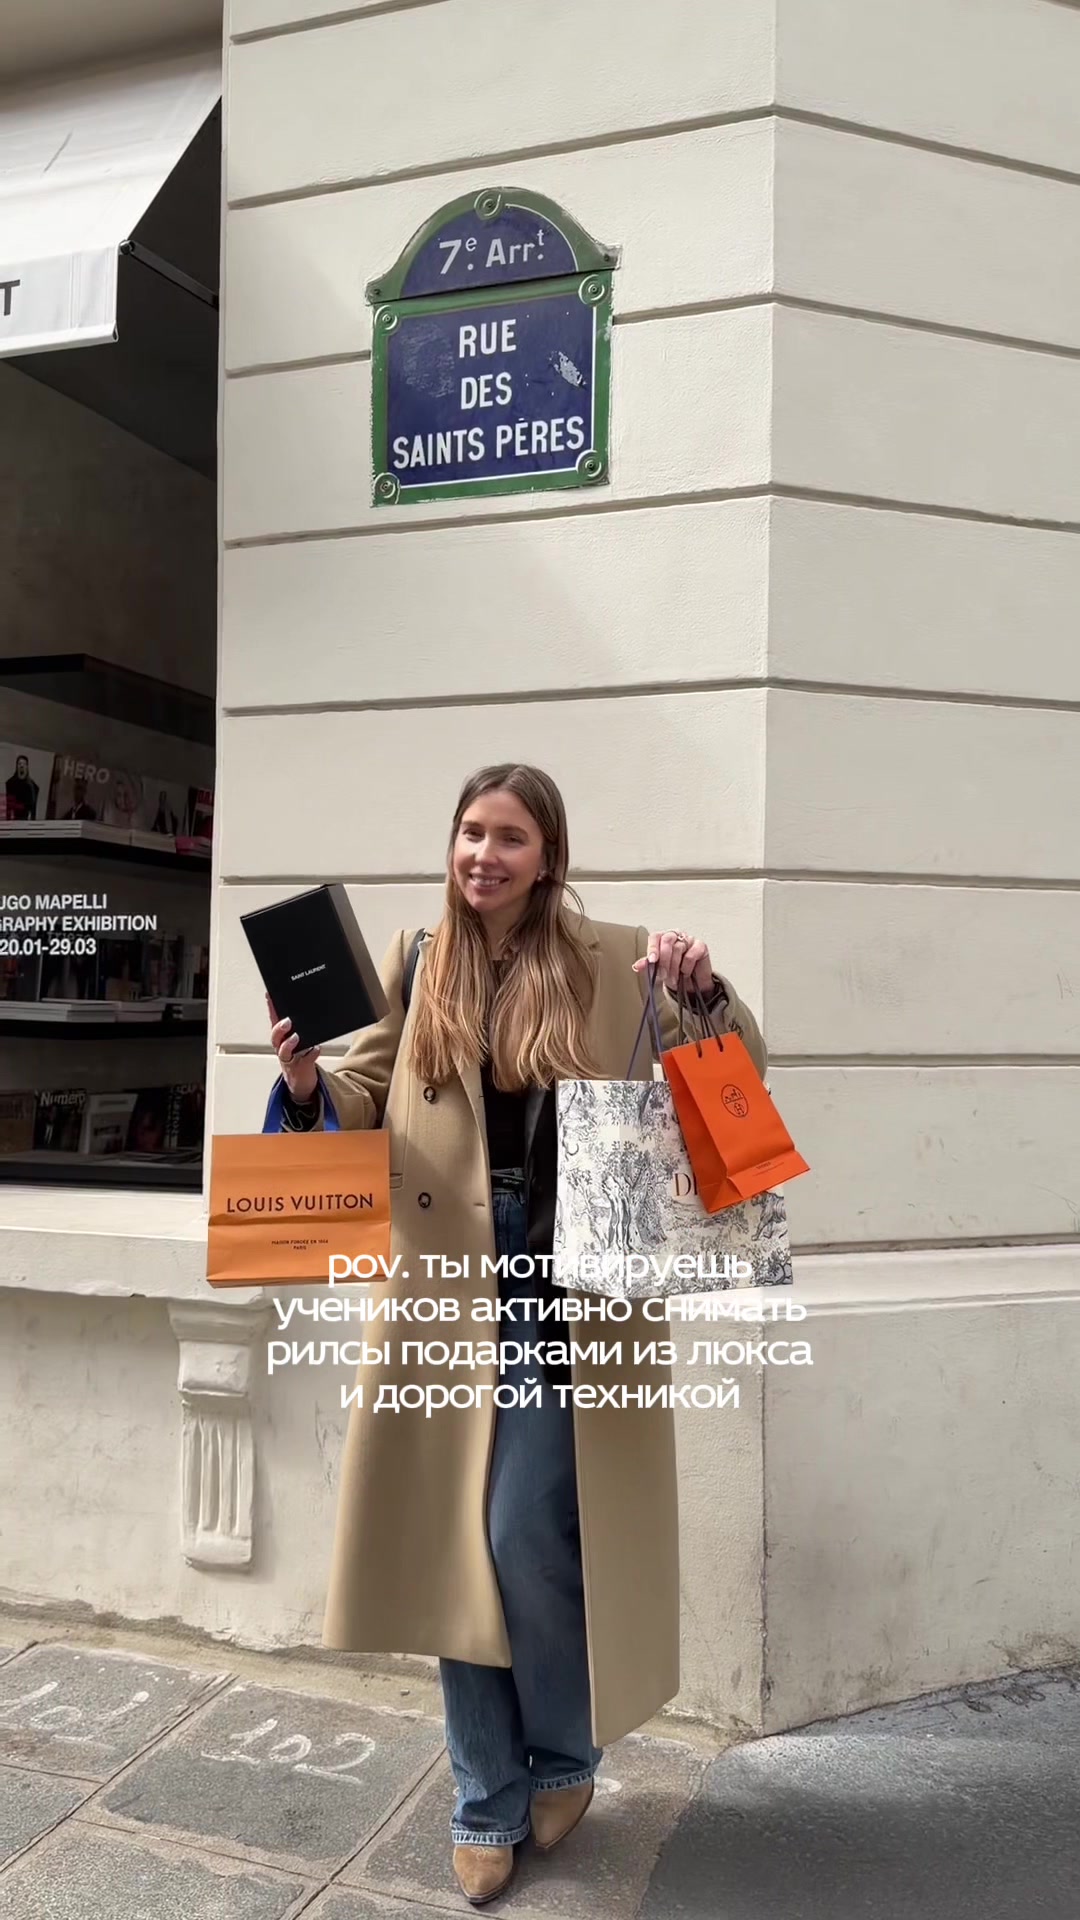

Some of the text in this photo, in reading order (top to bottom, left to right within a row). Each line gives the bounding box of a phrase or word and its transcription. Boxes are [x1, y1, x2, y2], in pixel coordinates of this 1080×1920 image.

[459, 319, 517, 358] RUE
[460, 371, 513, 410] DES
[392, 426, 485, 469] SAINTS
[63, 757, 110, 784] HERO
[35, 893, 107, 911] MAPELLI
[0, 914, 157, 932] RAPHY EXHIBITION
[226, 1193, 374, 1213] LOUIS VUITTON
[200, 1717, 376, 1785] 102
